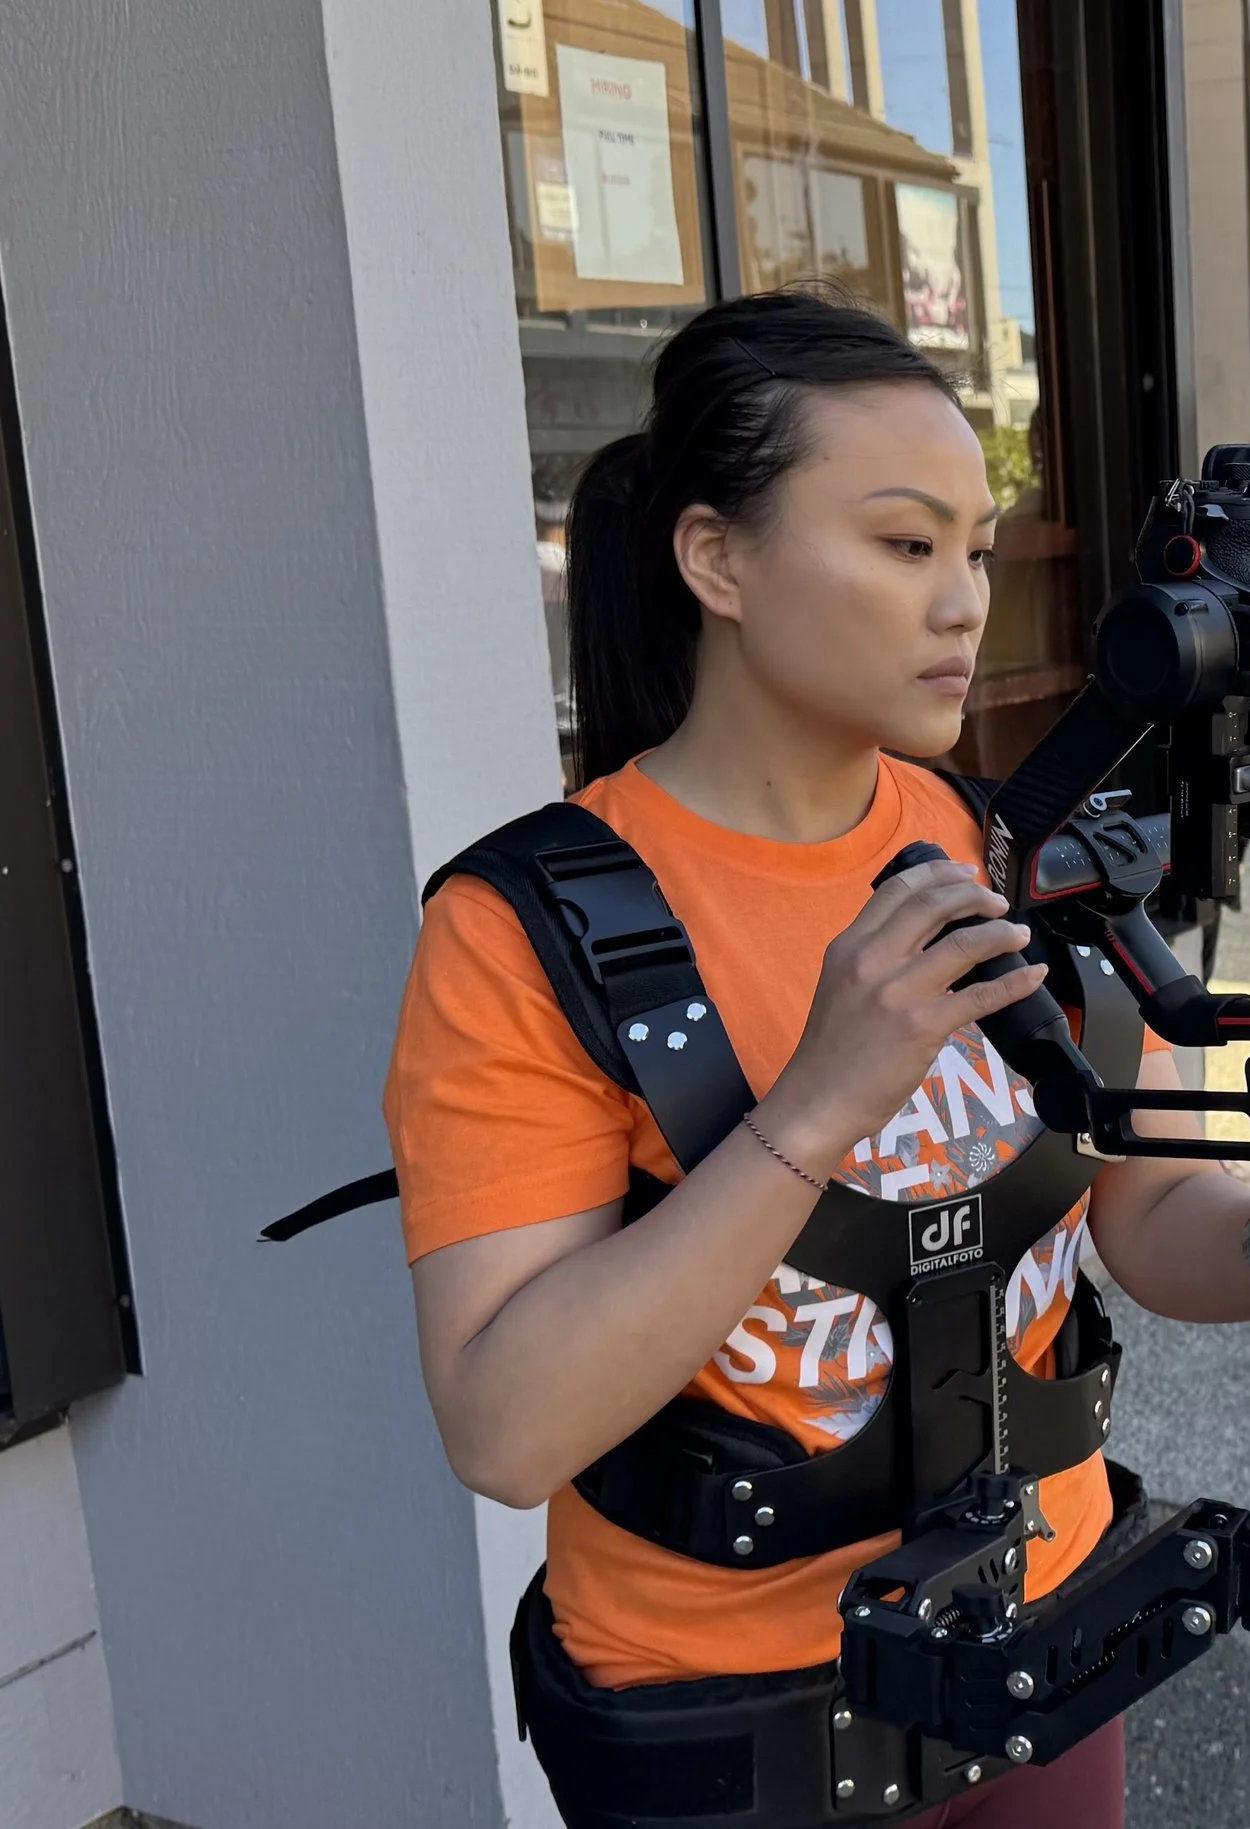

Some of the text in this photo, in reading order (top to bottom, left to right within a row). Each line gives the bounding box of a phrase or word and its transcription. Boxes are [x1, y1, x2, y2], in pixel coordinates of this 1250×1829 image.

[590, 78, 633, 101] HIRING
[987, 812, 1015, 894] RONIN
[921, 1204, 971, 1252] df
[910, 1248, 984, 1276] DIGITALFOTO
